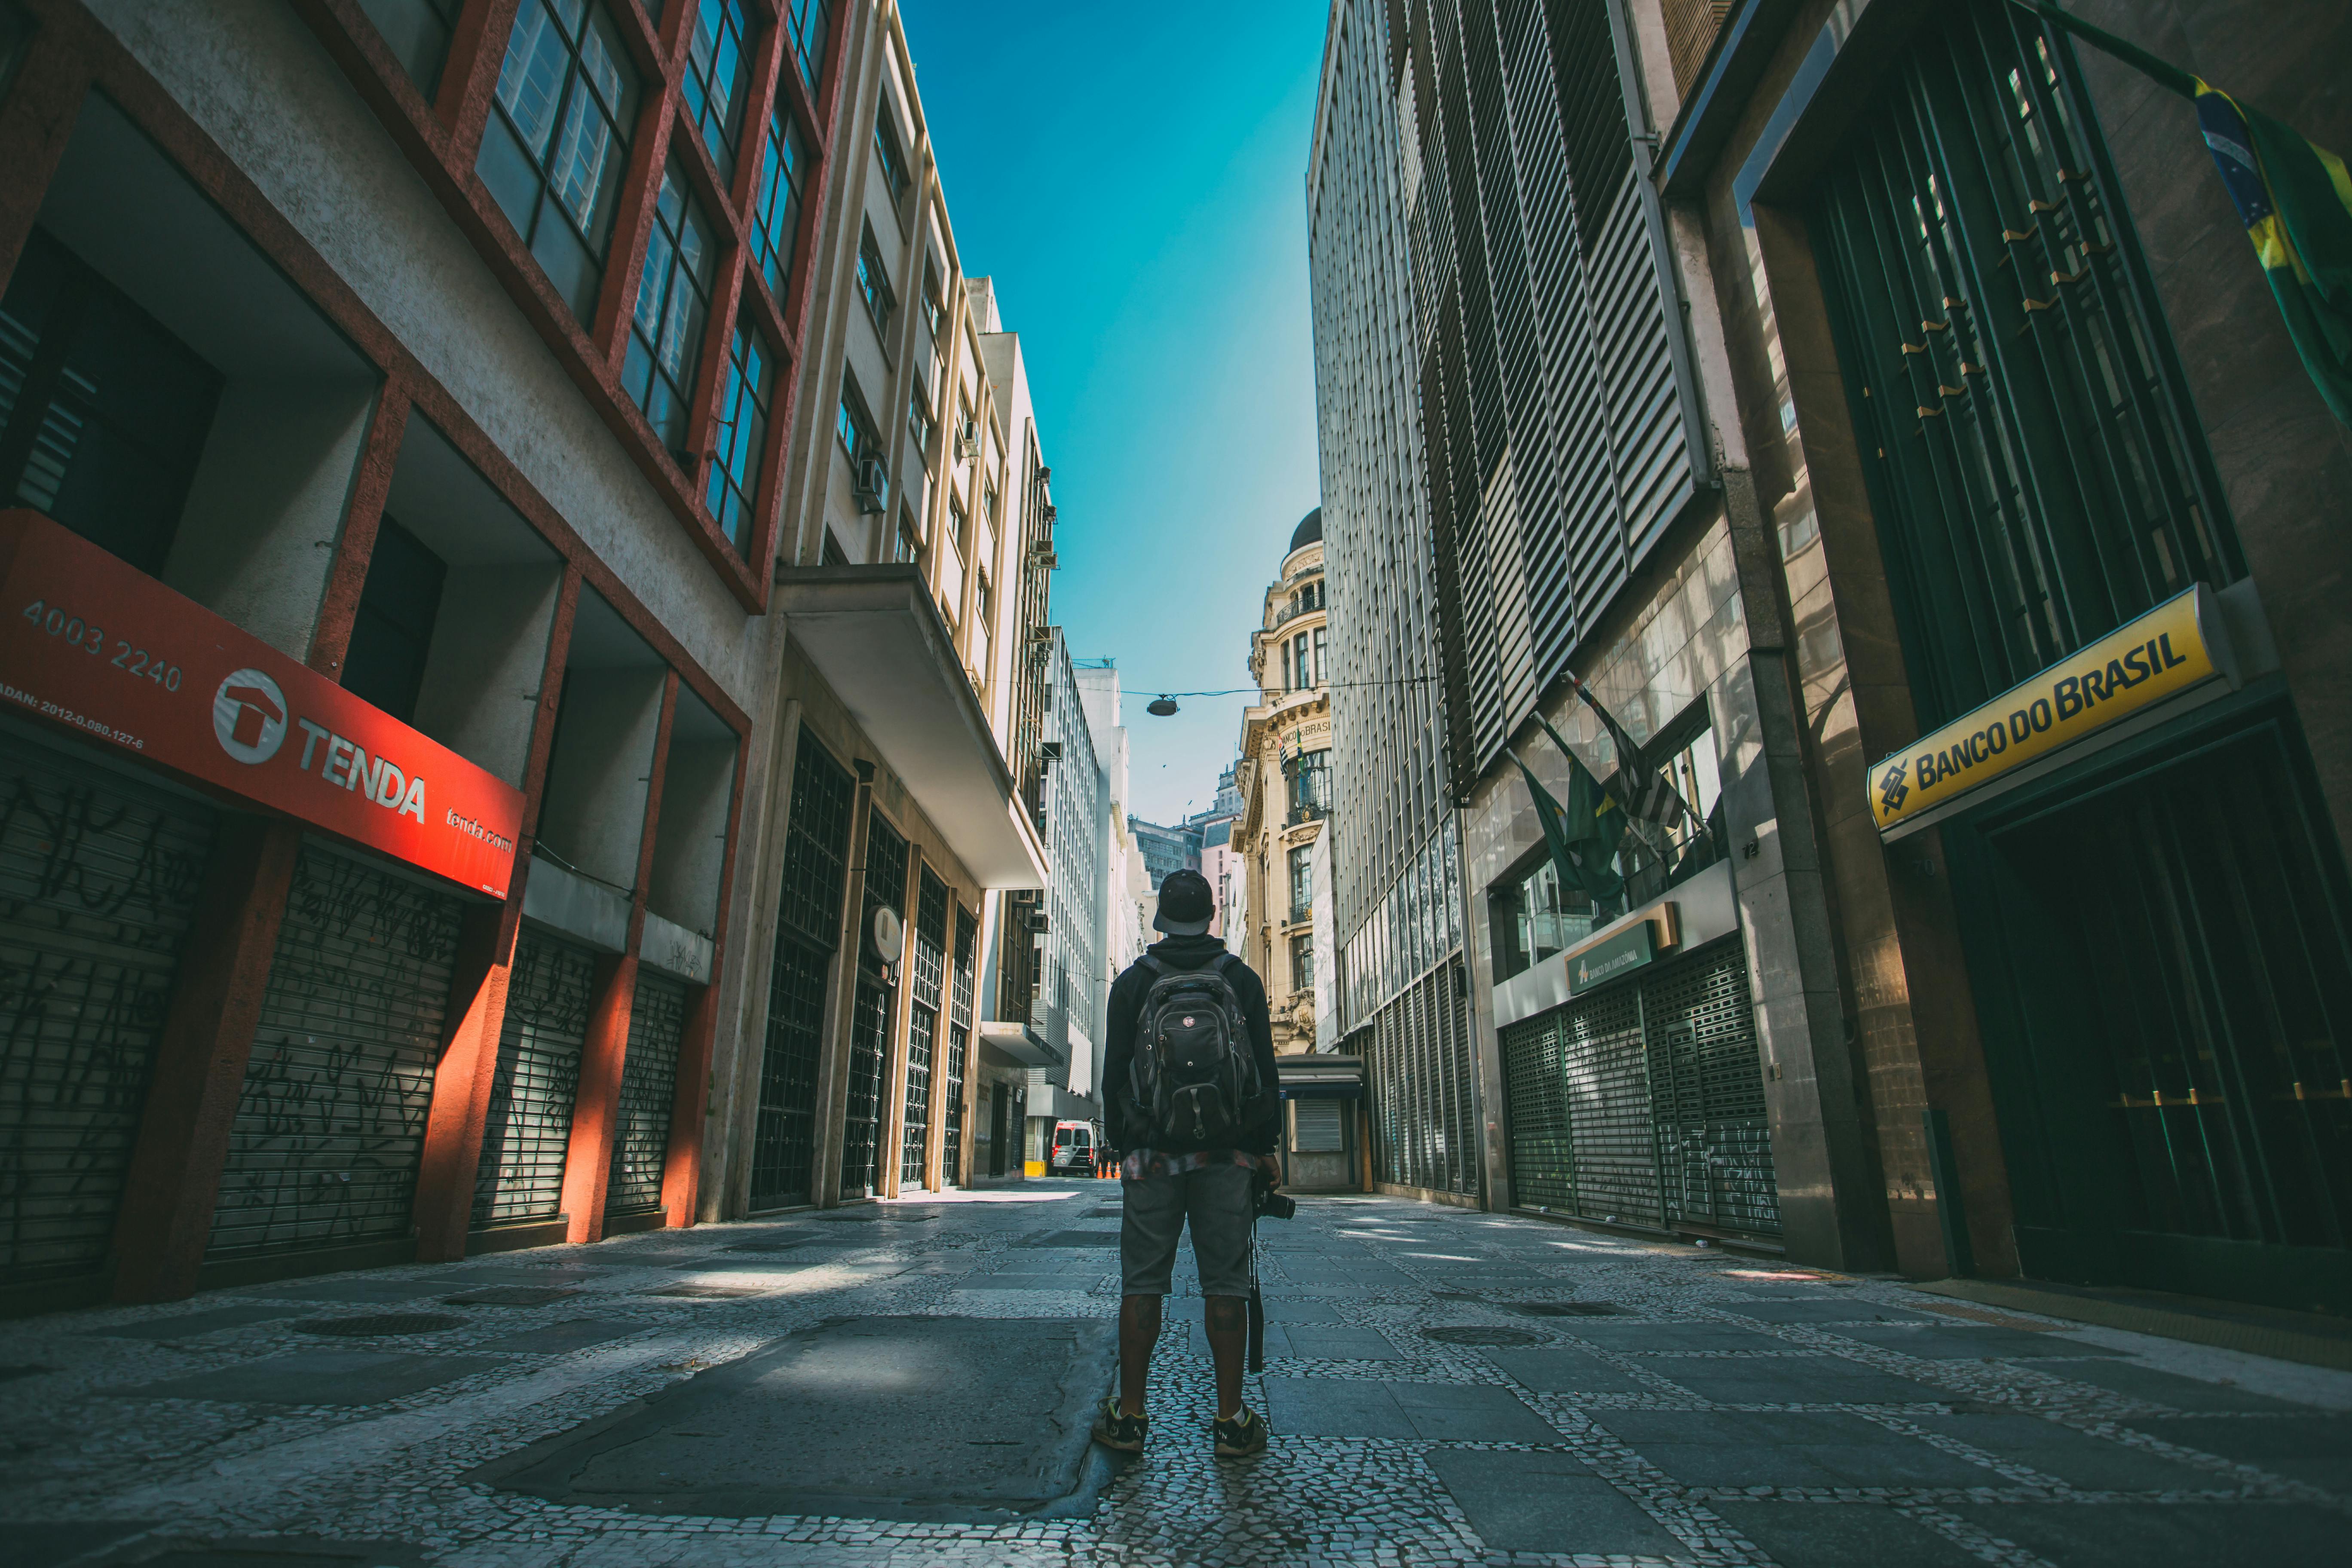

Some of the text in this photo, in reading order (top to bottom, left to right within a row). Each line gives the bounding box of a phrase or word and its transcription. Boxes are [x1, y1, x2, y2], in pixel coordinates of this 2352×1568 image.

[23, 599, 182, 692] 4003 2240
[40, 701, 144, 749] 2012-0.080.127-6
[1915, 632, 2187, 791] BANCO DO BRASIL
[299, 715, 425, 825] TENDA
[447, 806, 512, 854] tenda.com
[1589, 949, 1638, 980] BANCO DA AMAZÔNIA
